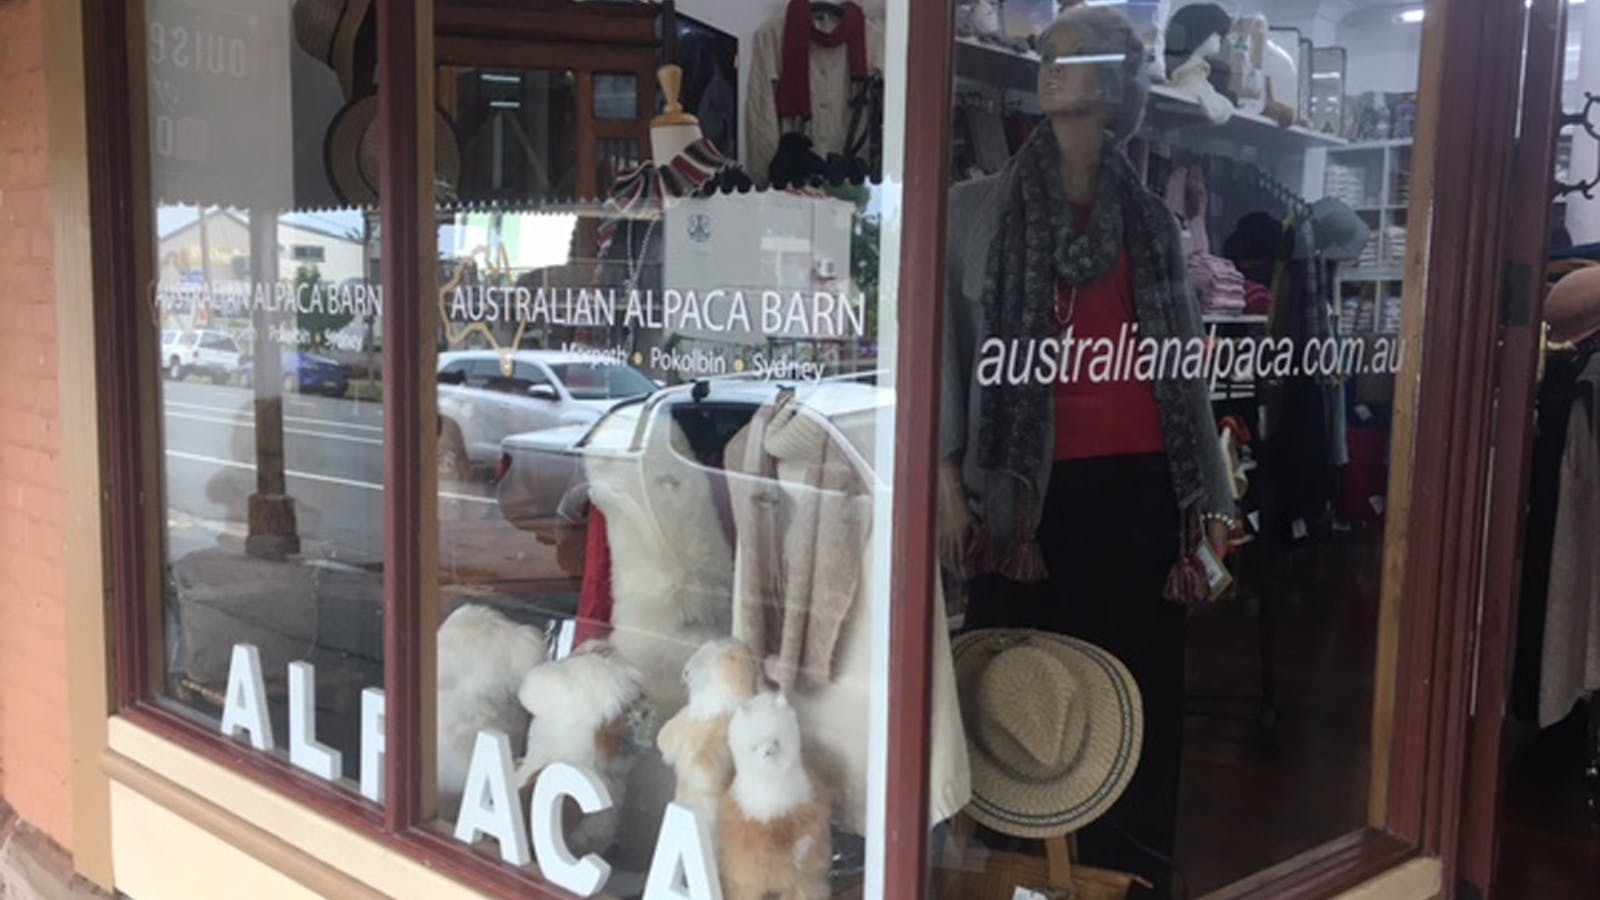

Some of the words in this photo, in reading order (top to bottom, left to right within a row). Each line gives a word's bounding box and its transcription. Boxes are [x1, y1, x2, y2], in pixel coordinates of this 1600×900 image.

[253, 281, 323, 314] ALPACA
[326, 284, 384, 317] BARN
[450, 285, 614, 328] AUSTRALIAN
[623, 288, 752, 334] ALPACA
[761, 291, 867, 338] BARN
[651, 347, 726, 373] Pokolbin
[752, 352, 827, 386] Sydney
[976, 323, 1407, 393] australianalpaca.com.au
